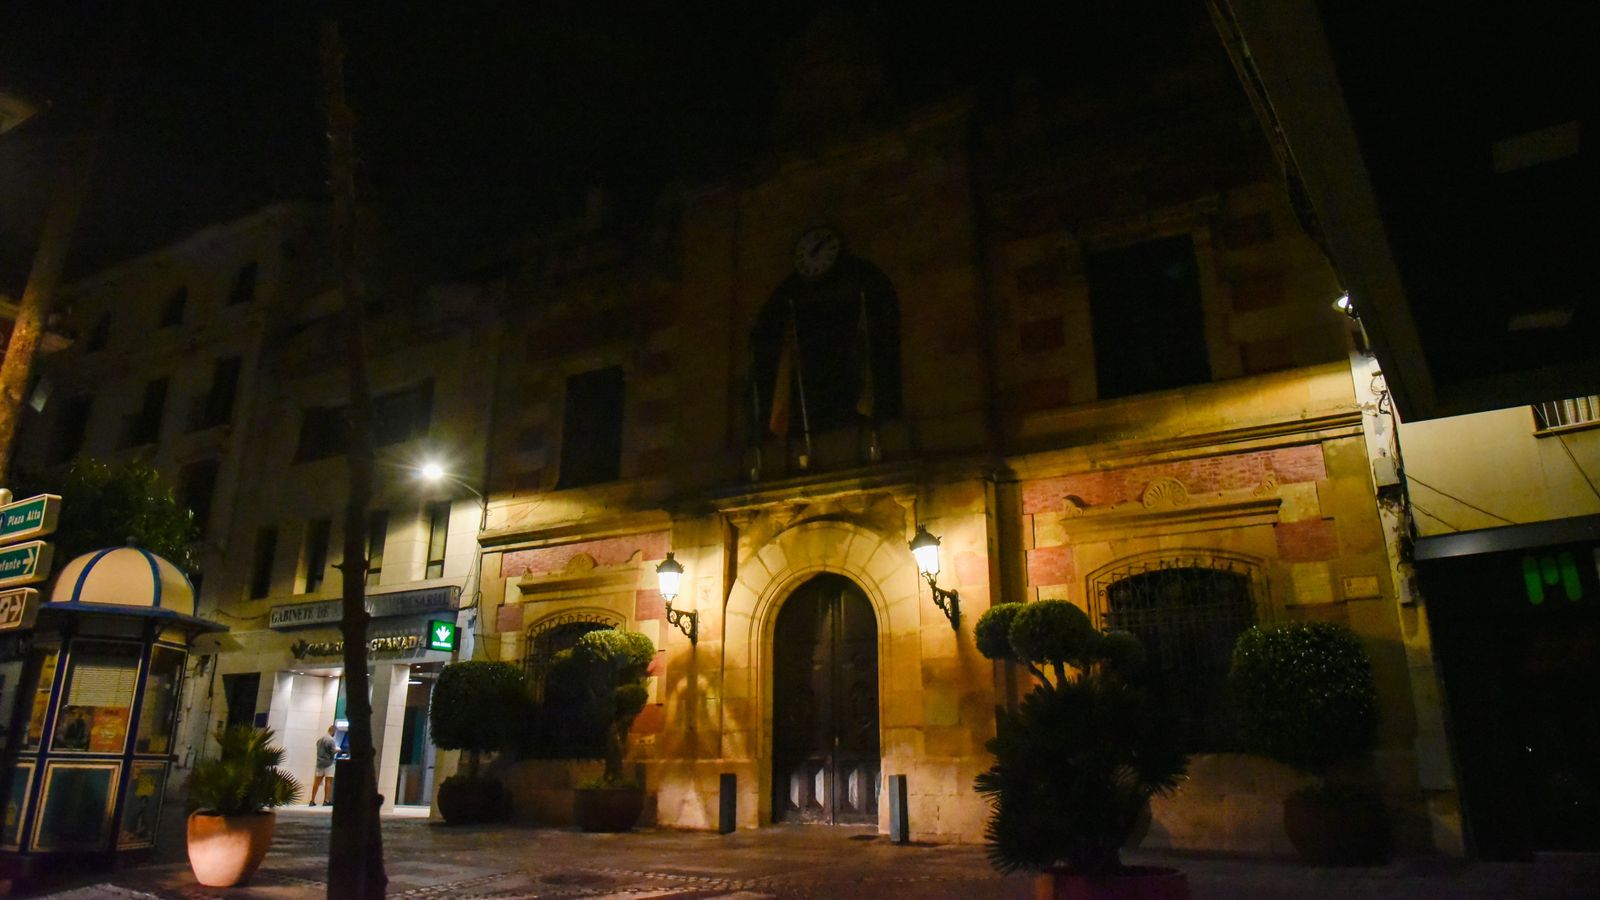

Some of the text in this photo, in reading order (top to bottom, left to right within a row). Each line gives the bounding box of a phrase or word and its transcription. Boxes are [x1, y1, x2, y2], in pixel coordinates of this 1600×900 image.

[7, 510, 41, 526] Plaza Alta
[271, 607, 313, 623] GABINETE
[371, 635, 427, 651] GRANADA
